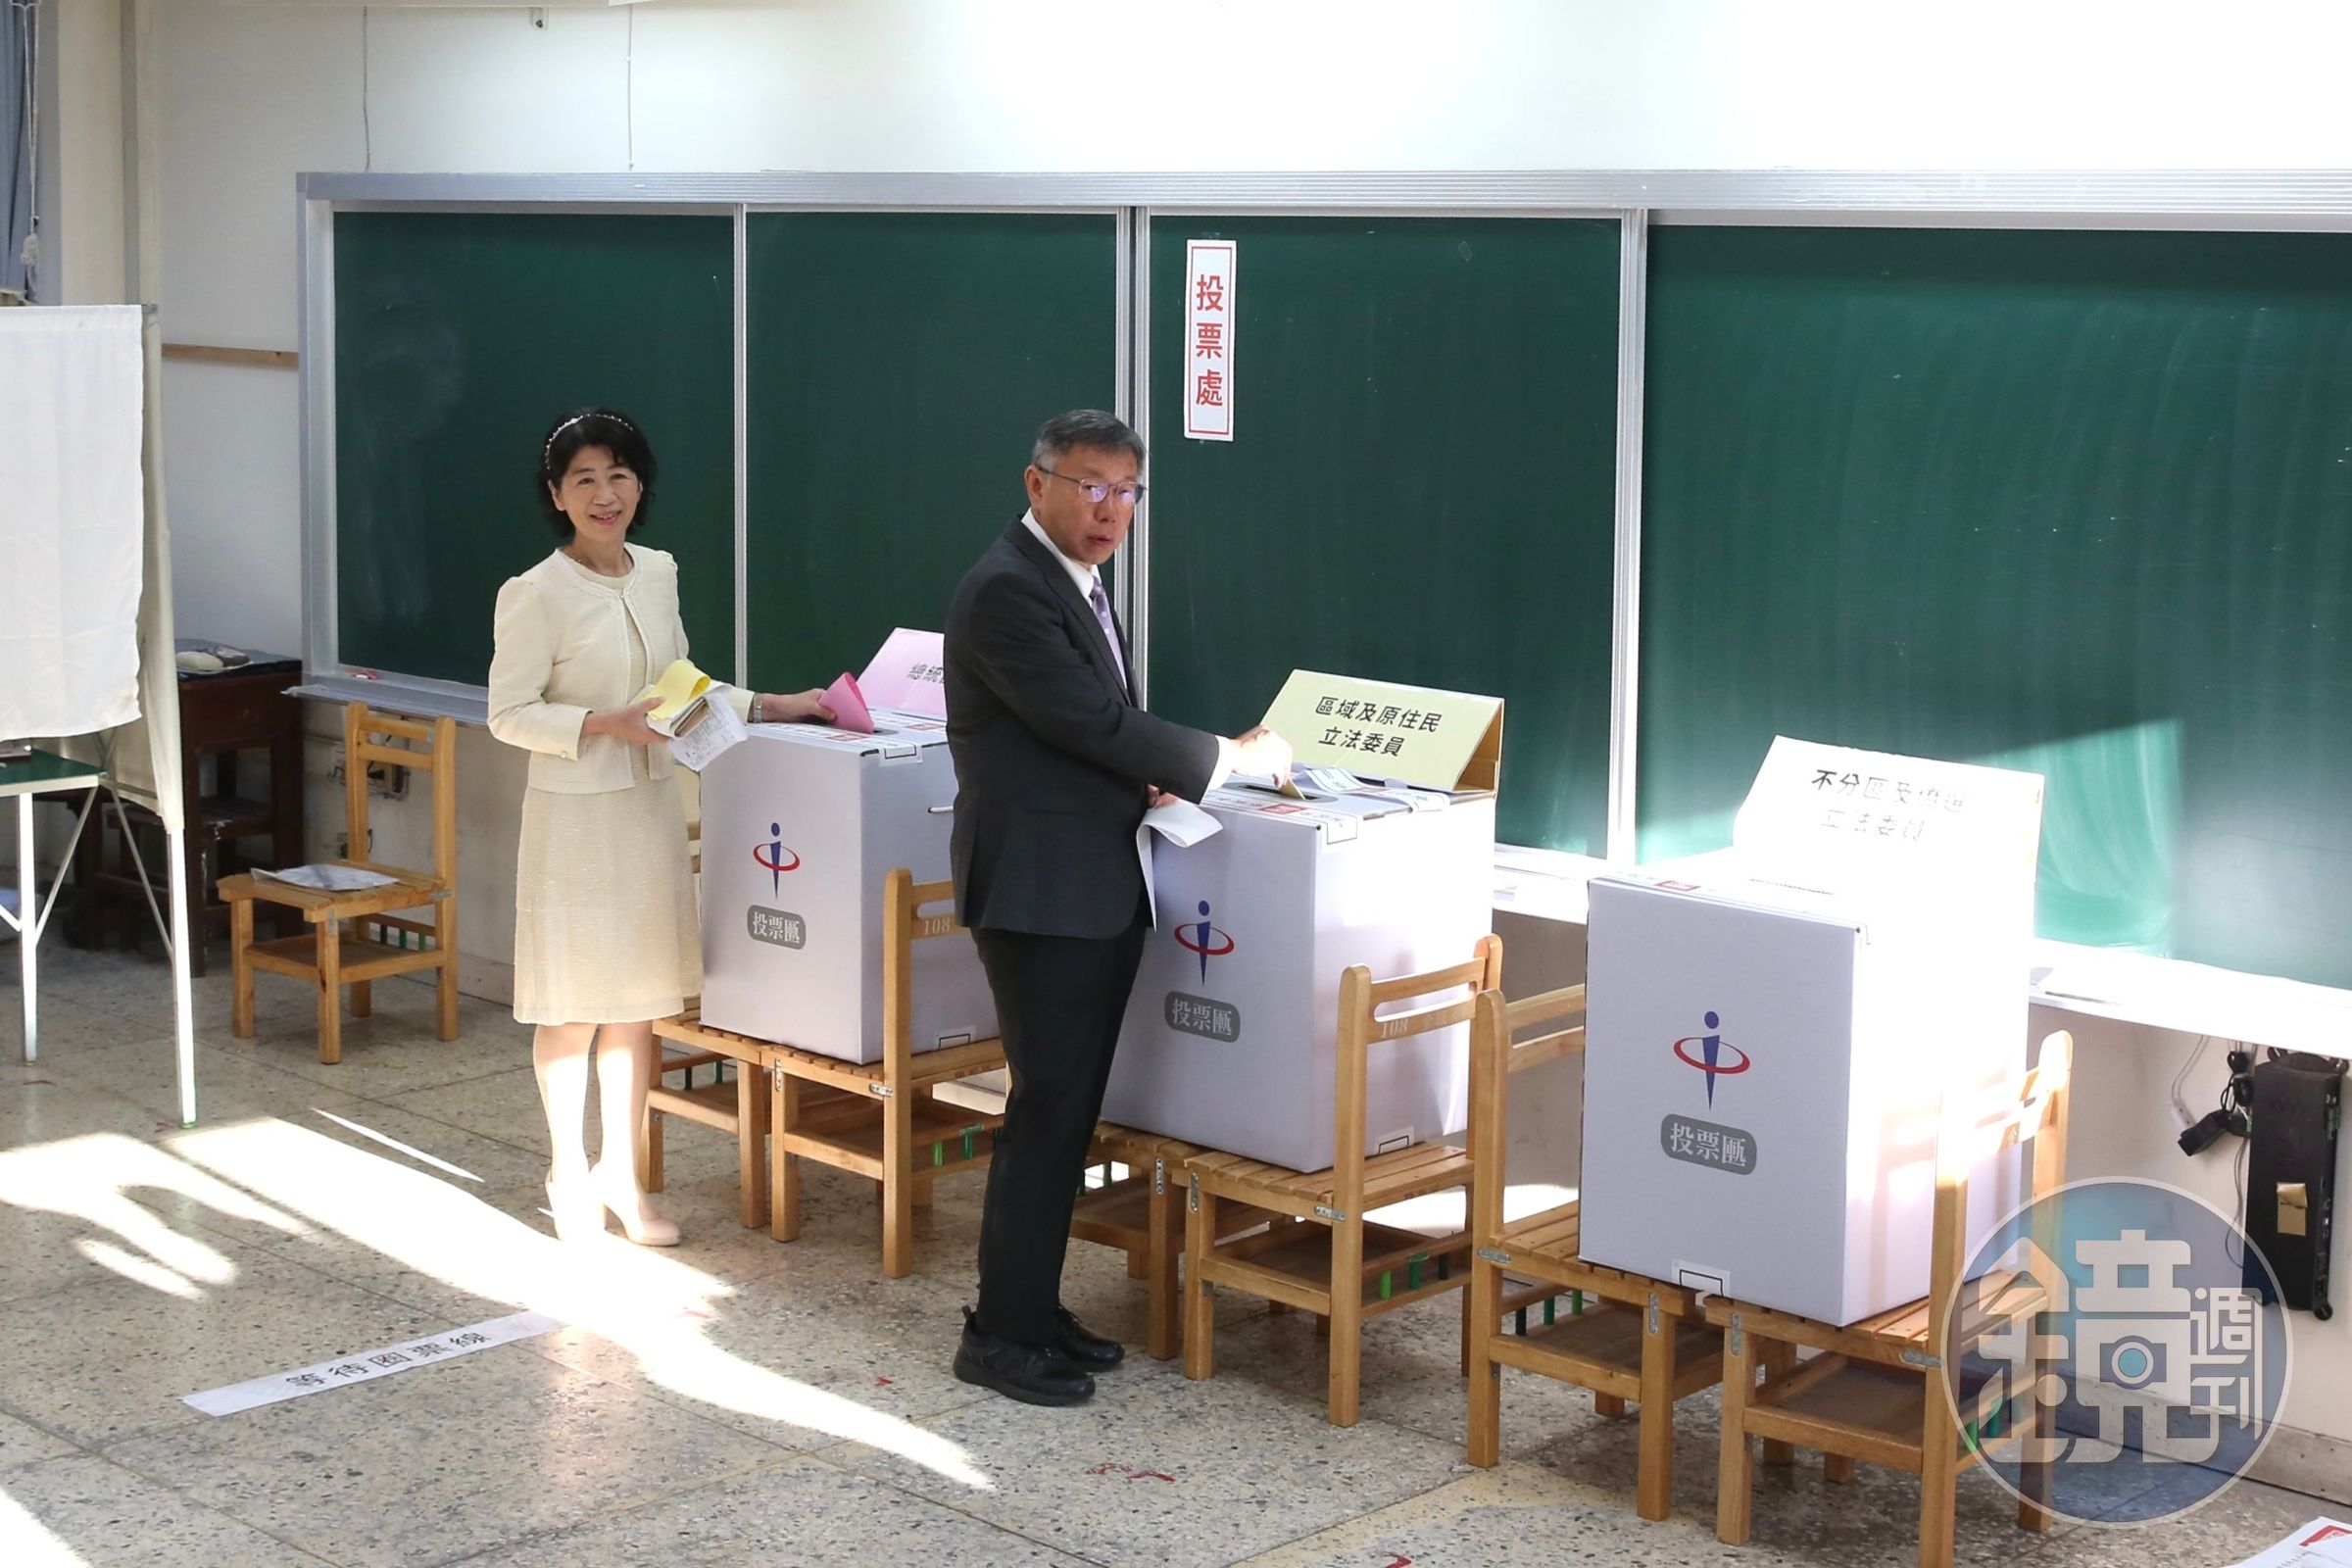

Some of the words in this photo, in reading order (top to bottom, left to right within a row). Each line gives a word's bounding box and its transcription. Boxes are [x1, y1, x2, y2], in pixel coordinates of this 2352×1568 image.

[1196, 273, 1224, 407] 投票處
[1314, 695, 1444, 734] 區域及原住民
[1317, 725, 1406, 758] 立法委員
[924, 916, 951, 936] 108
[1379, 1018, 1408, 1039] 108
